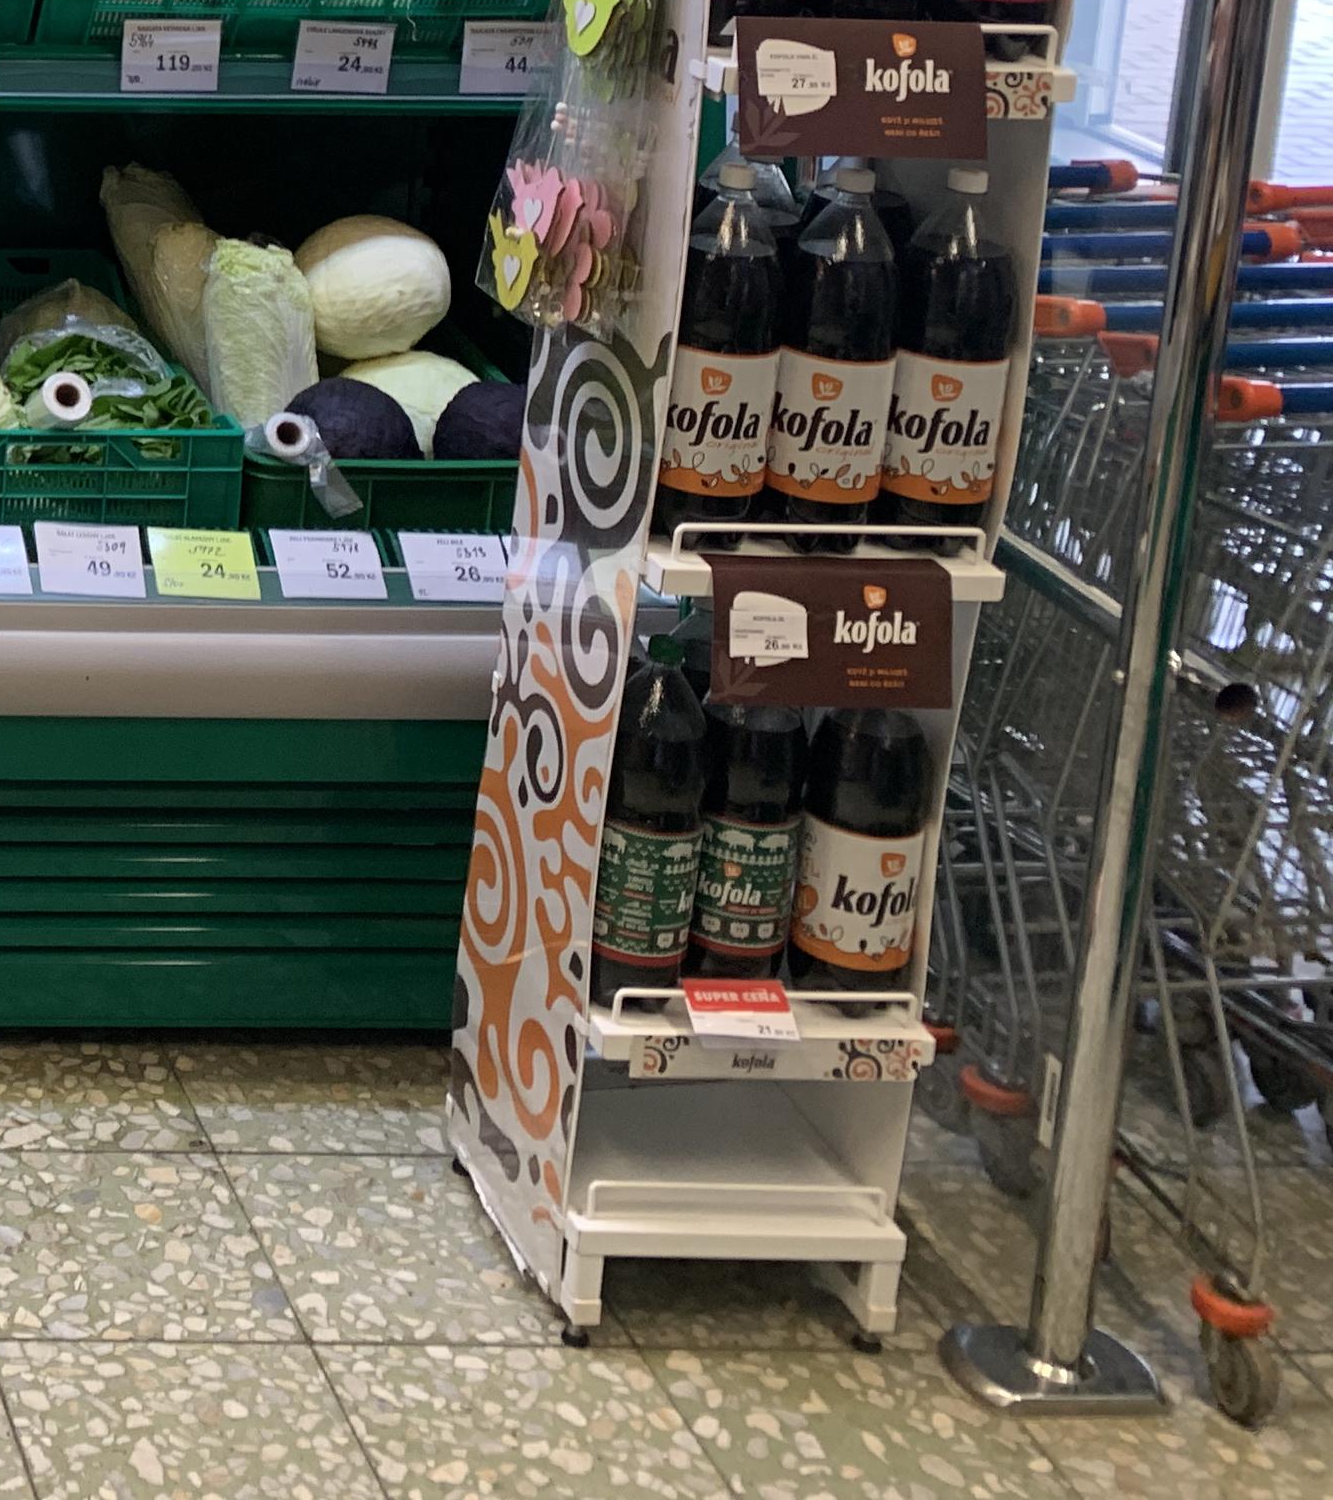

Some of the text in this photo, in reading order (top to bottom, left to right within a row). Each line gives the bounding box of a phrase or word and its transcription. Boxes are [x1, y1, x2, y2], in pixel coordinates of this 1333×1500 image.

[791, 77, 806, 89] 27
[864, 57, 951, 103] kofola
[771, 392, 873, 451] kofola
[887, 394, 991, 453] kofola
[764, 639, 779, 650] 26
[833, 610, 918, 654] kofola
[698, 874, 762, 907] kofola
[831, 875, 916, 928] kofol
[693, 988, 780, 1003] SUPER CENA
[731, 1051, 776, 1072] kofola
